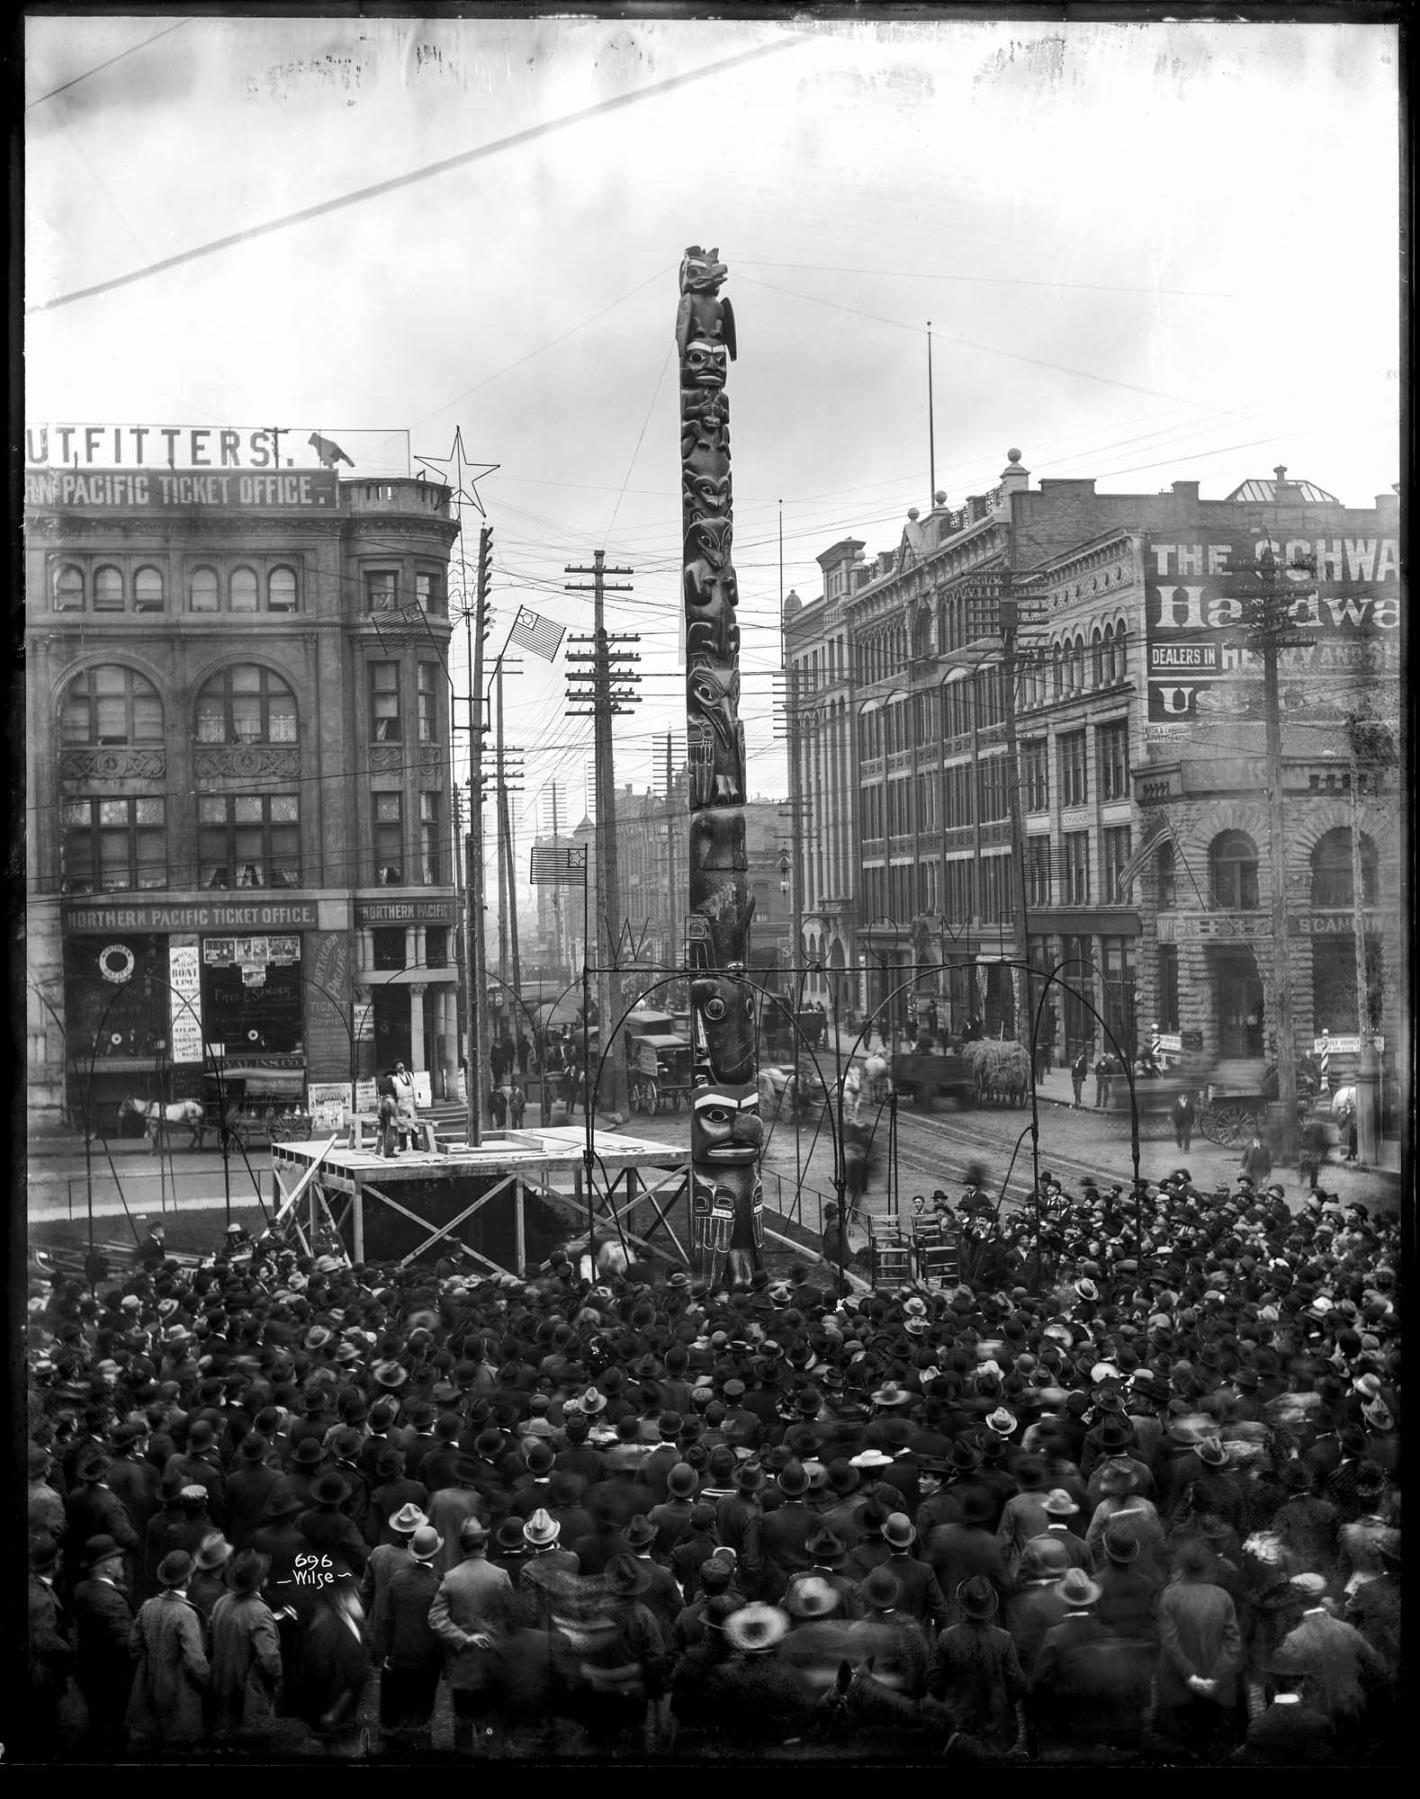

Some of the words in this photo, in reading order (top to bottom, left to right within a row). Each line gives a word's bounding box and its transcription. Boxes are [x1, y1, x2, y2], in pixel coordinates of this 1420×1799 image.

[27, 427, 294, 467] UTFITTERS.
[62, 475, 149, 504] PACIFIC
[158, 475, 230, 504] TICKET
[1151, 543, 1234, 577] THE
[1155, 584, 1400, 629] Hadwa
[1152, 648, 1201, 664] DEALERS
[1204, 648, 1216, 664] IN
[67, 911, 147, 928] NORTHERN
[151, 908, 208, 926] PACIFIC
[213, 908, 259, 924] TICKET
[262, 907, 315, 924] OFFICE.
[362, 904, 415, 920] NORTHERN
[417, 903, 449, 919] PACIFIC
